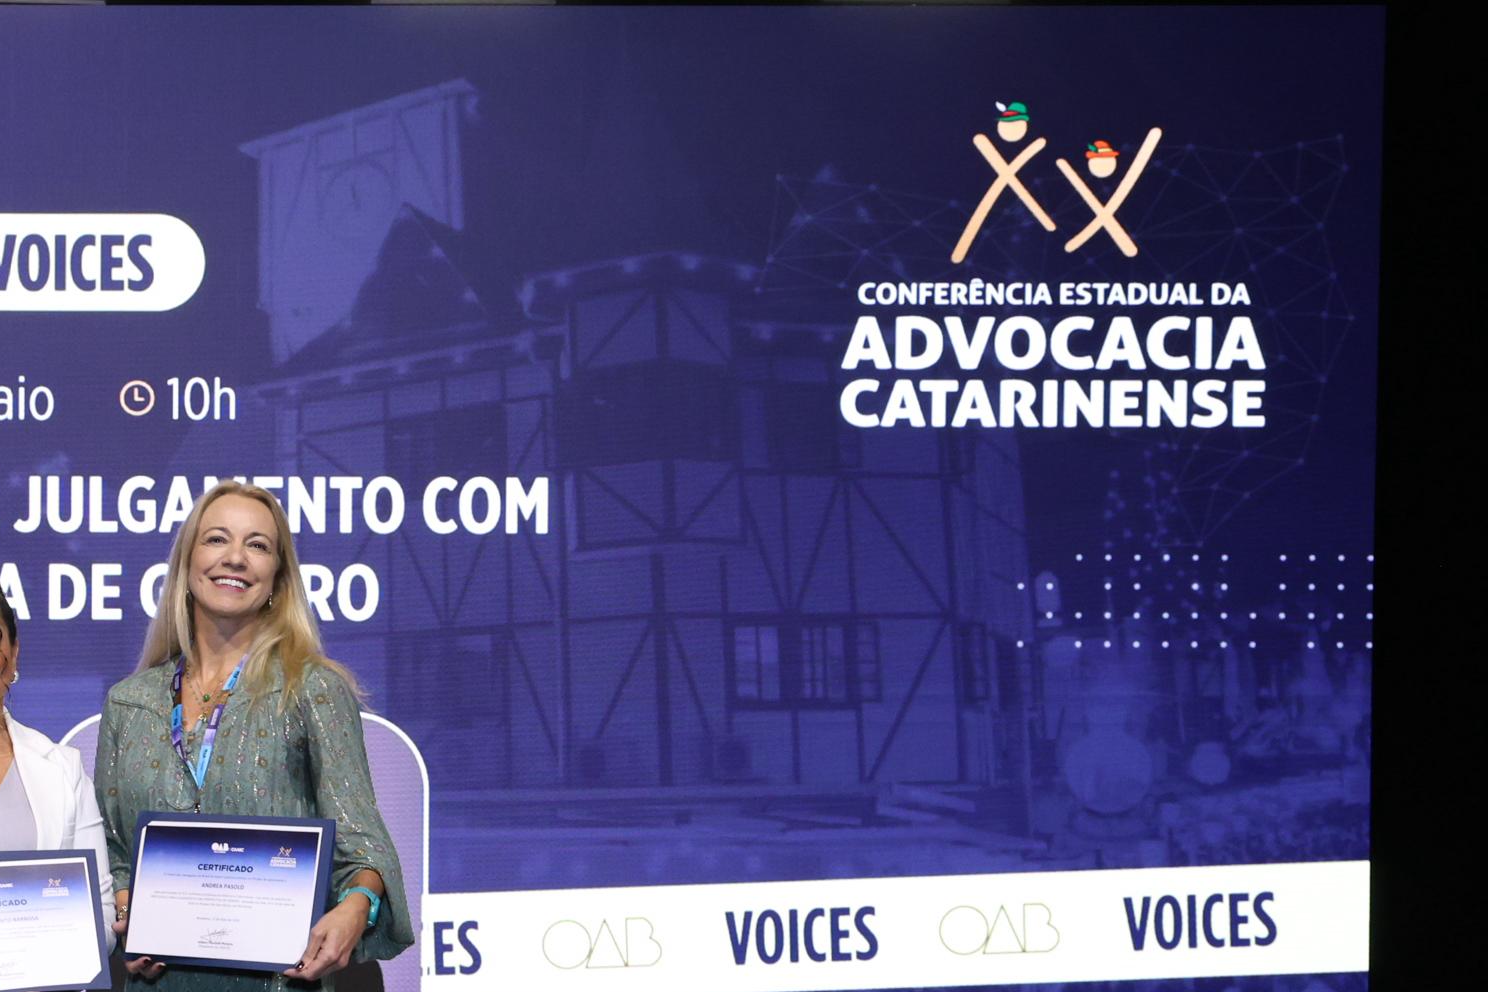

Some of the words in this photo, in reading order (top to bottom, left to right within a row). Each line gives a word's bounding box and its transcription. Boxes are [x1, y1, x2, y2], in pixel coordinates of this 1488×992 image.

[857, 277, 1053, 306] CONFERÊNCIA
[1059, 282, 1204, 306] ESTADUAL
[1211, 282, 1251, 306] DA
[840, 315, 1266, 371] ADVOCACIA
[166, 376, 236, 421] 10h
[839, 378, 1266, 428] CATARINENSE
[13, 475, 406, 535] JULGANTO
[422, 476, 549, 535] COM
[48, 562, 123, 621] DE
[197, 863, 254, 874] CERTIFICADO
[725, 905, 879, 966] VOICES
[1123, 891, 1278, 952] VOICES
